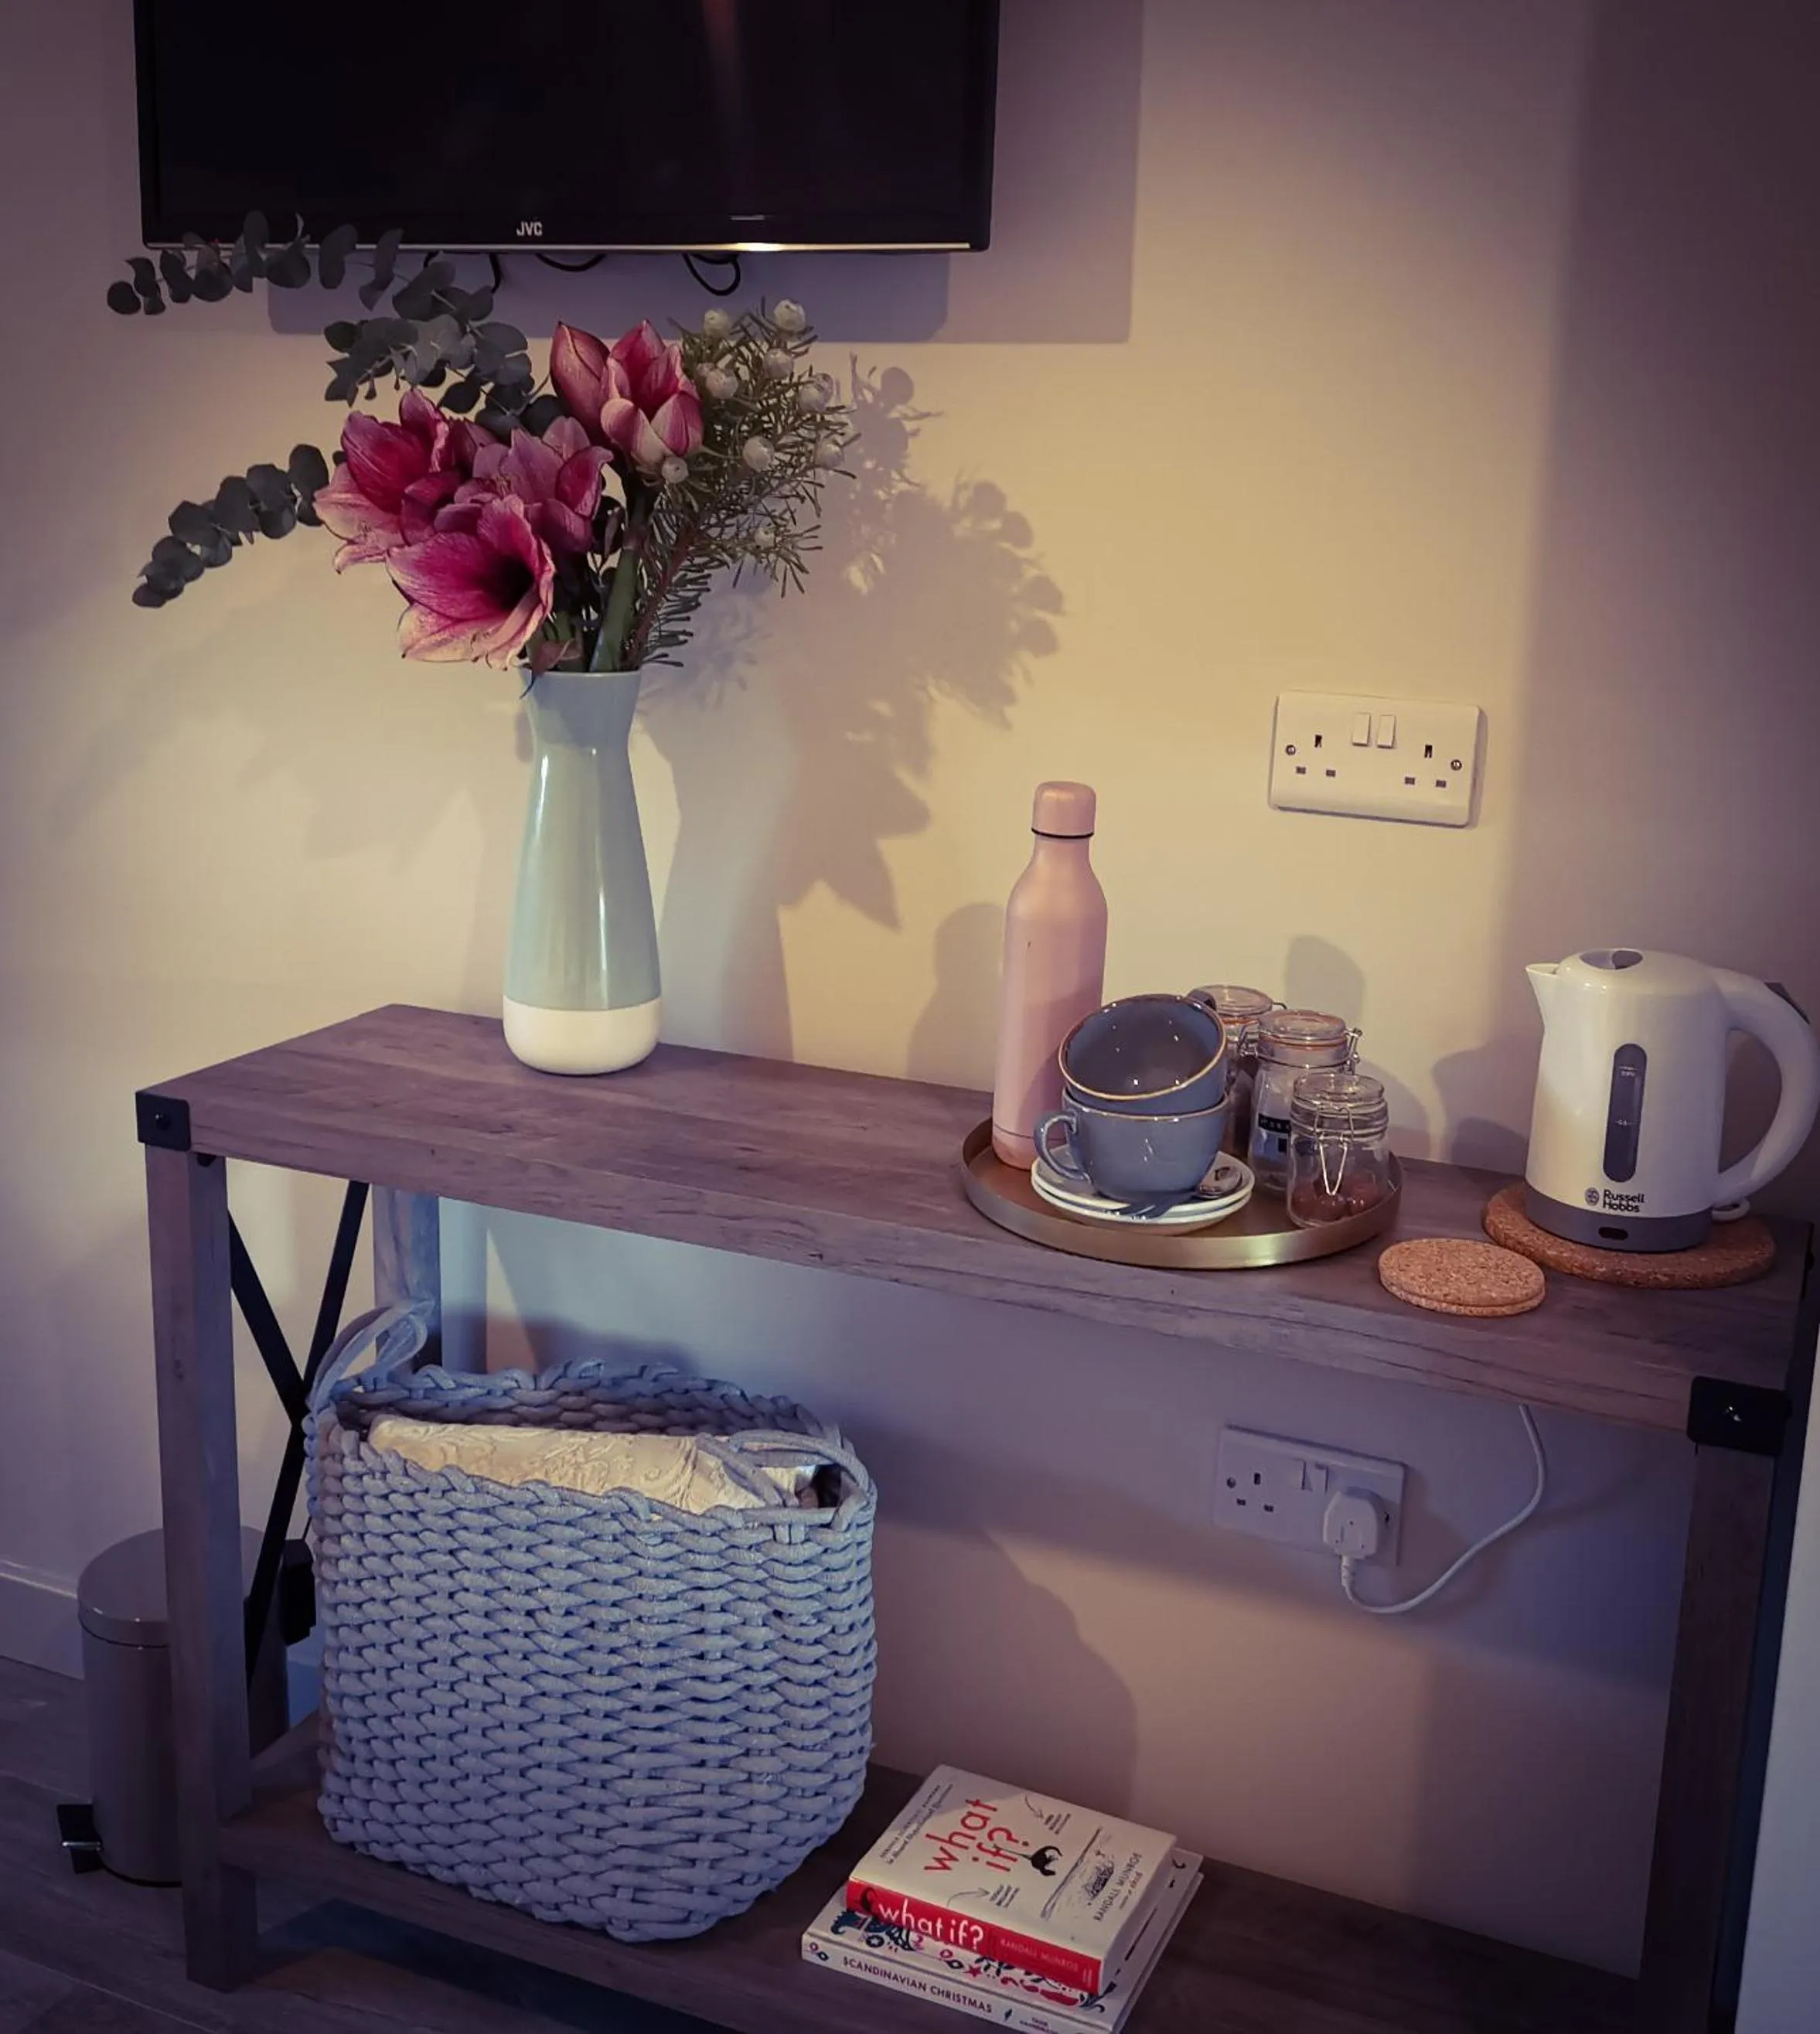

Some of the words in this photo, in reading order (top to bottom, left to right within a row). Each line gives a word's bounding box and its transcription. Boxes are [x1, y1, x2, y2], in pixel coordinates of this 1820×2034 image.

[516, 221, 543, 237] JVC
[1603, 1188, 1644, 1204] Russell
[1603, 1199, 1641, 1213] Hobbs
[923, 1798, 998, 1871] what
[971, 1827, 1030, 1872] if?
[1092, 1887, 1121, 1921] RANDALL
[878, 1898, 943, 1939] what
[949, 1919, 984, 1951] if?
[842, 1955, 927, 1992] SCANDINAVIAN
[929, 1985, 993, 2014] CHRISTMAS
